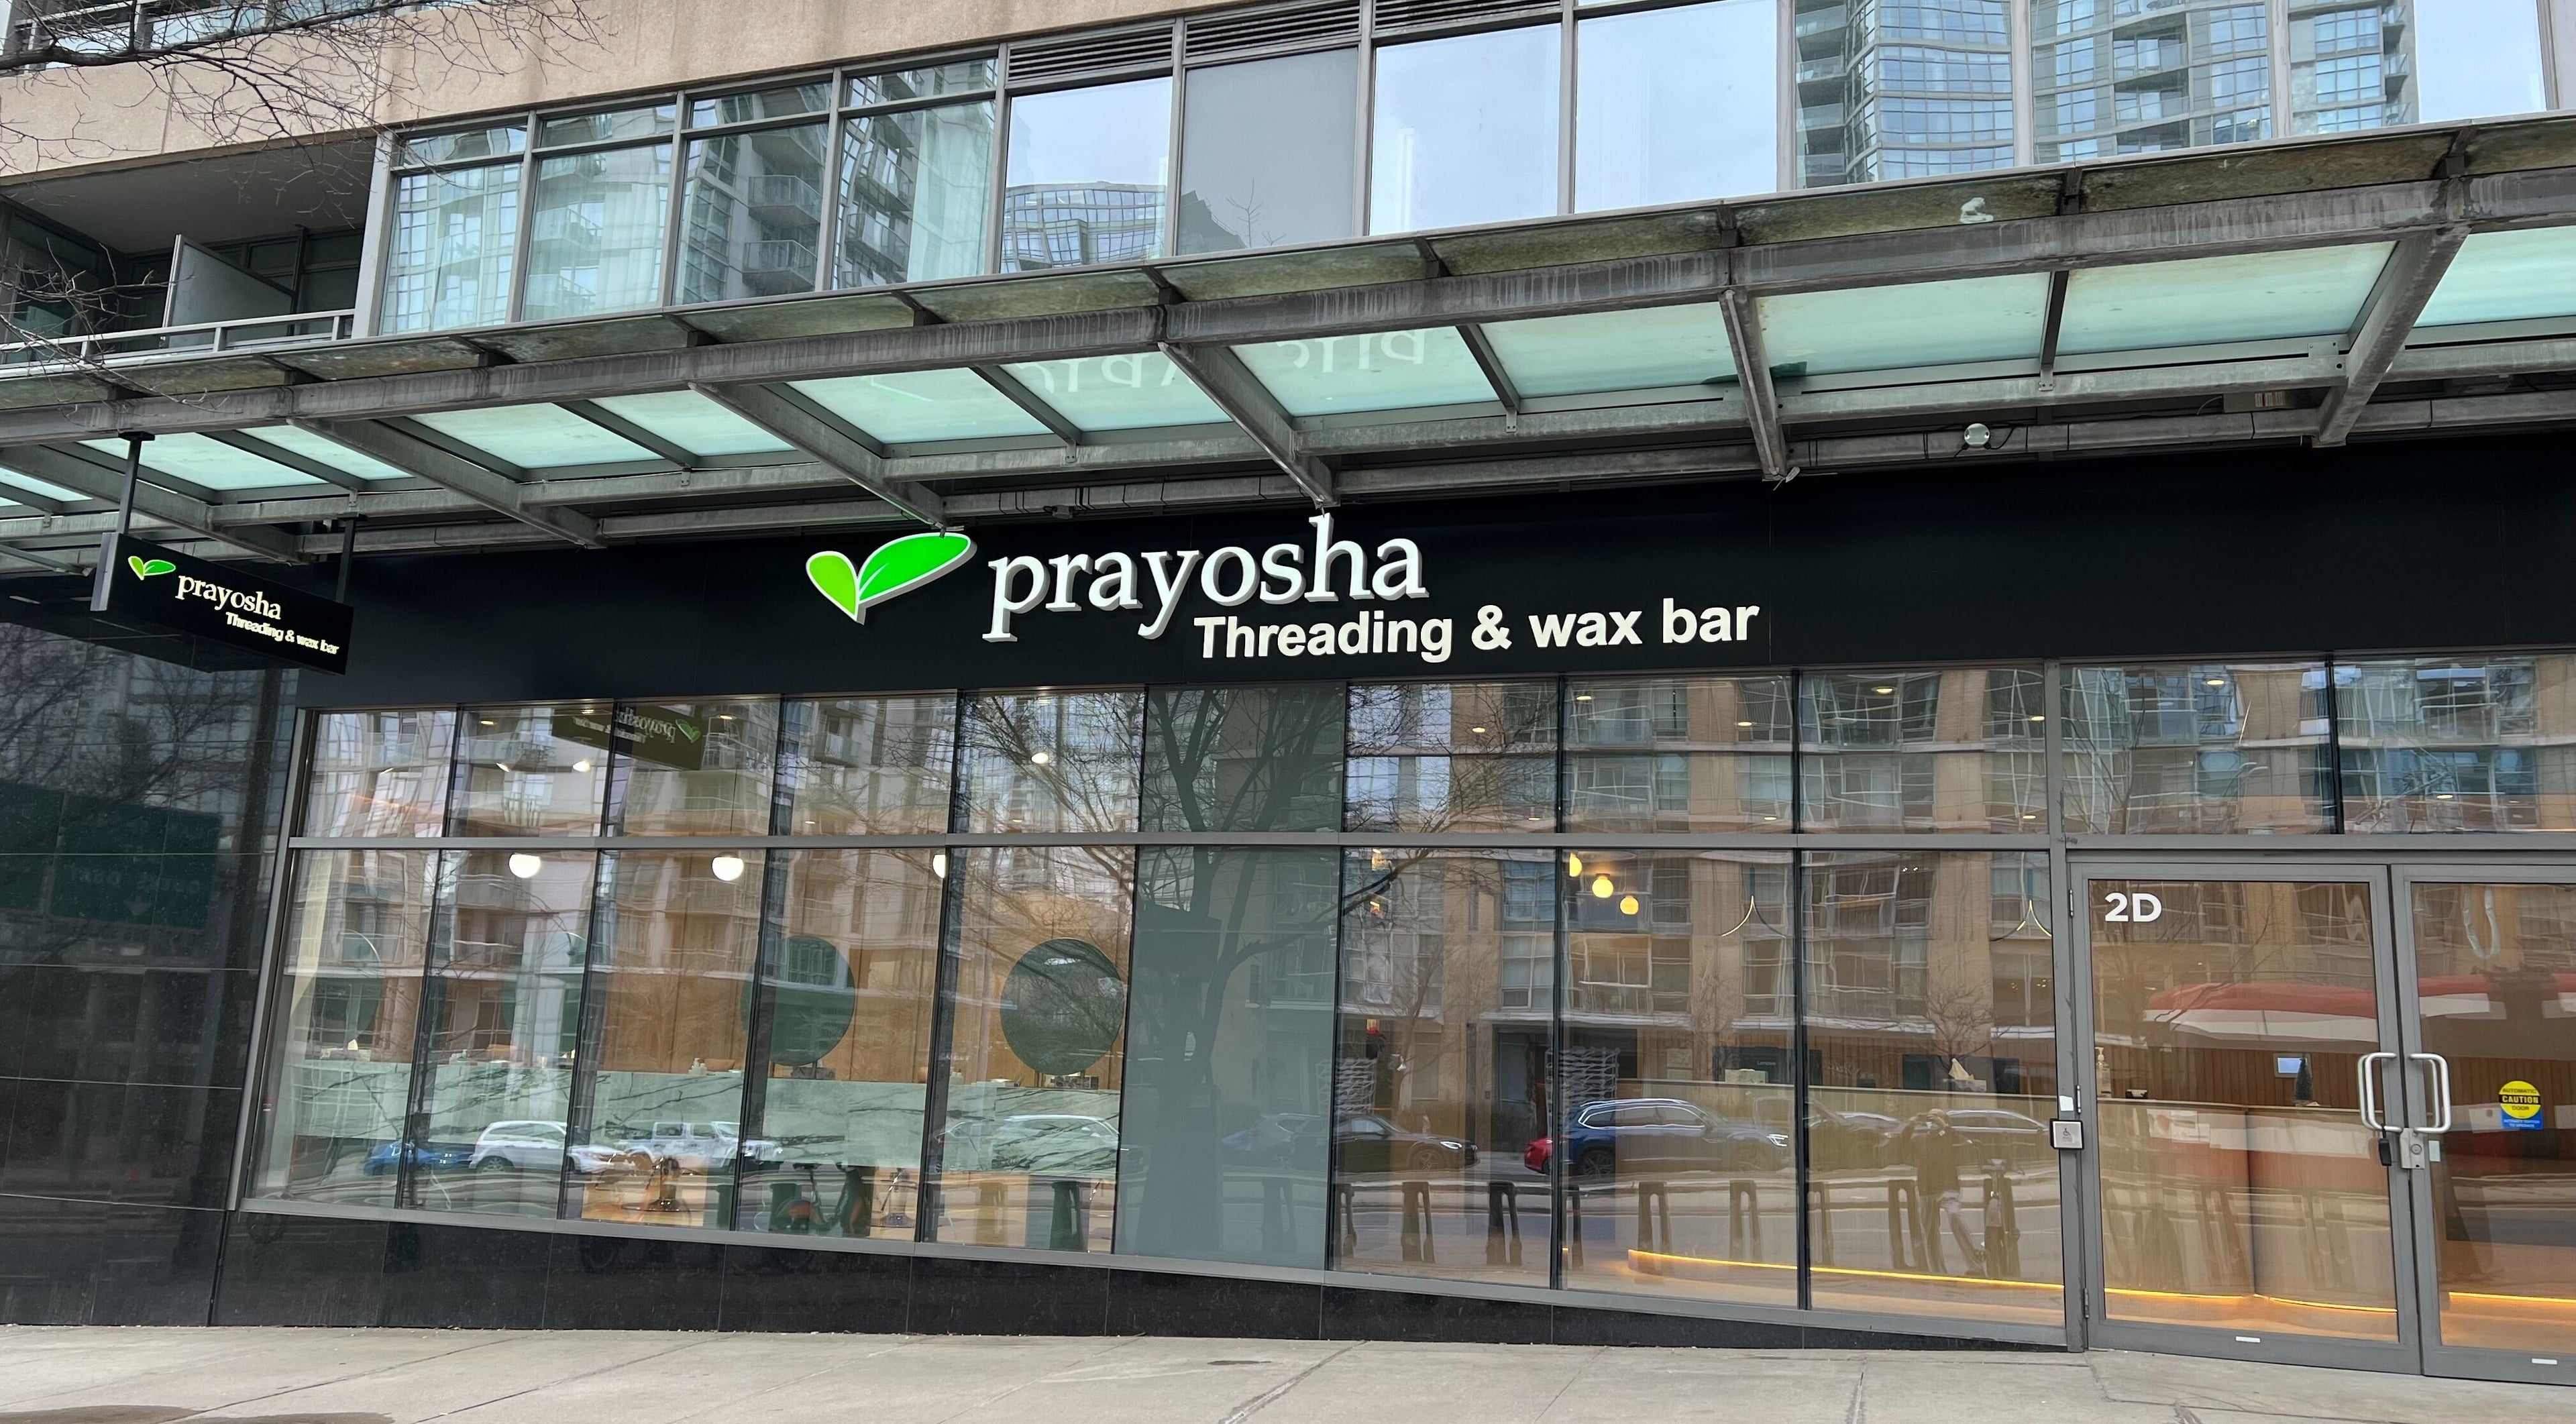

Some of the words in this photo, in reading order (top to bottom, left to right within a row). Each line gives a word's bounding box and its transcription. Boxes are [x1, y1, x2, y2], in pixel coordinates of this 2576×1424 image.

[175, 575, 281, 620] prayosha
[982, 512, 1429, 642] prayosha
[225, 611, 284, 642] Threading
[284, 629, 295, 643] &
[296, 635, 319, 650] wax
[319, 639, 340, 655] bar
[1194, 610, 1453, 663] Threading
[1471, 605, 1512, 650] &
[1529, 610, 1643, 648] wax
[1662, 598, 1761, 644] bar
[2104, 892, 2162, 922] 2D
[2502, 1095, 2538, 1103] CAUTION
